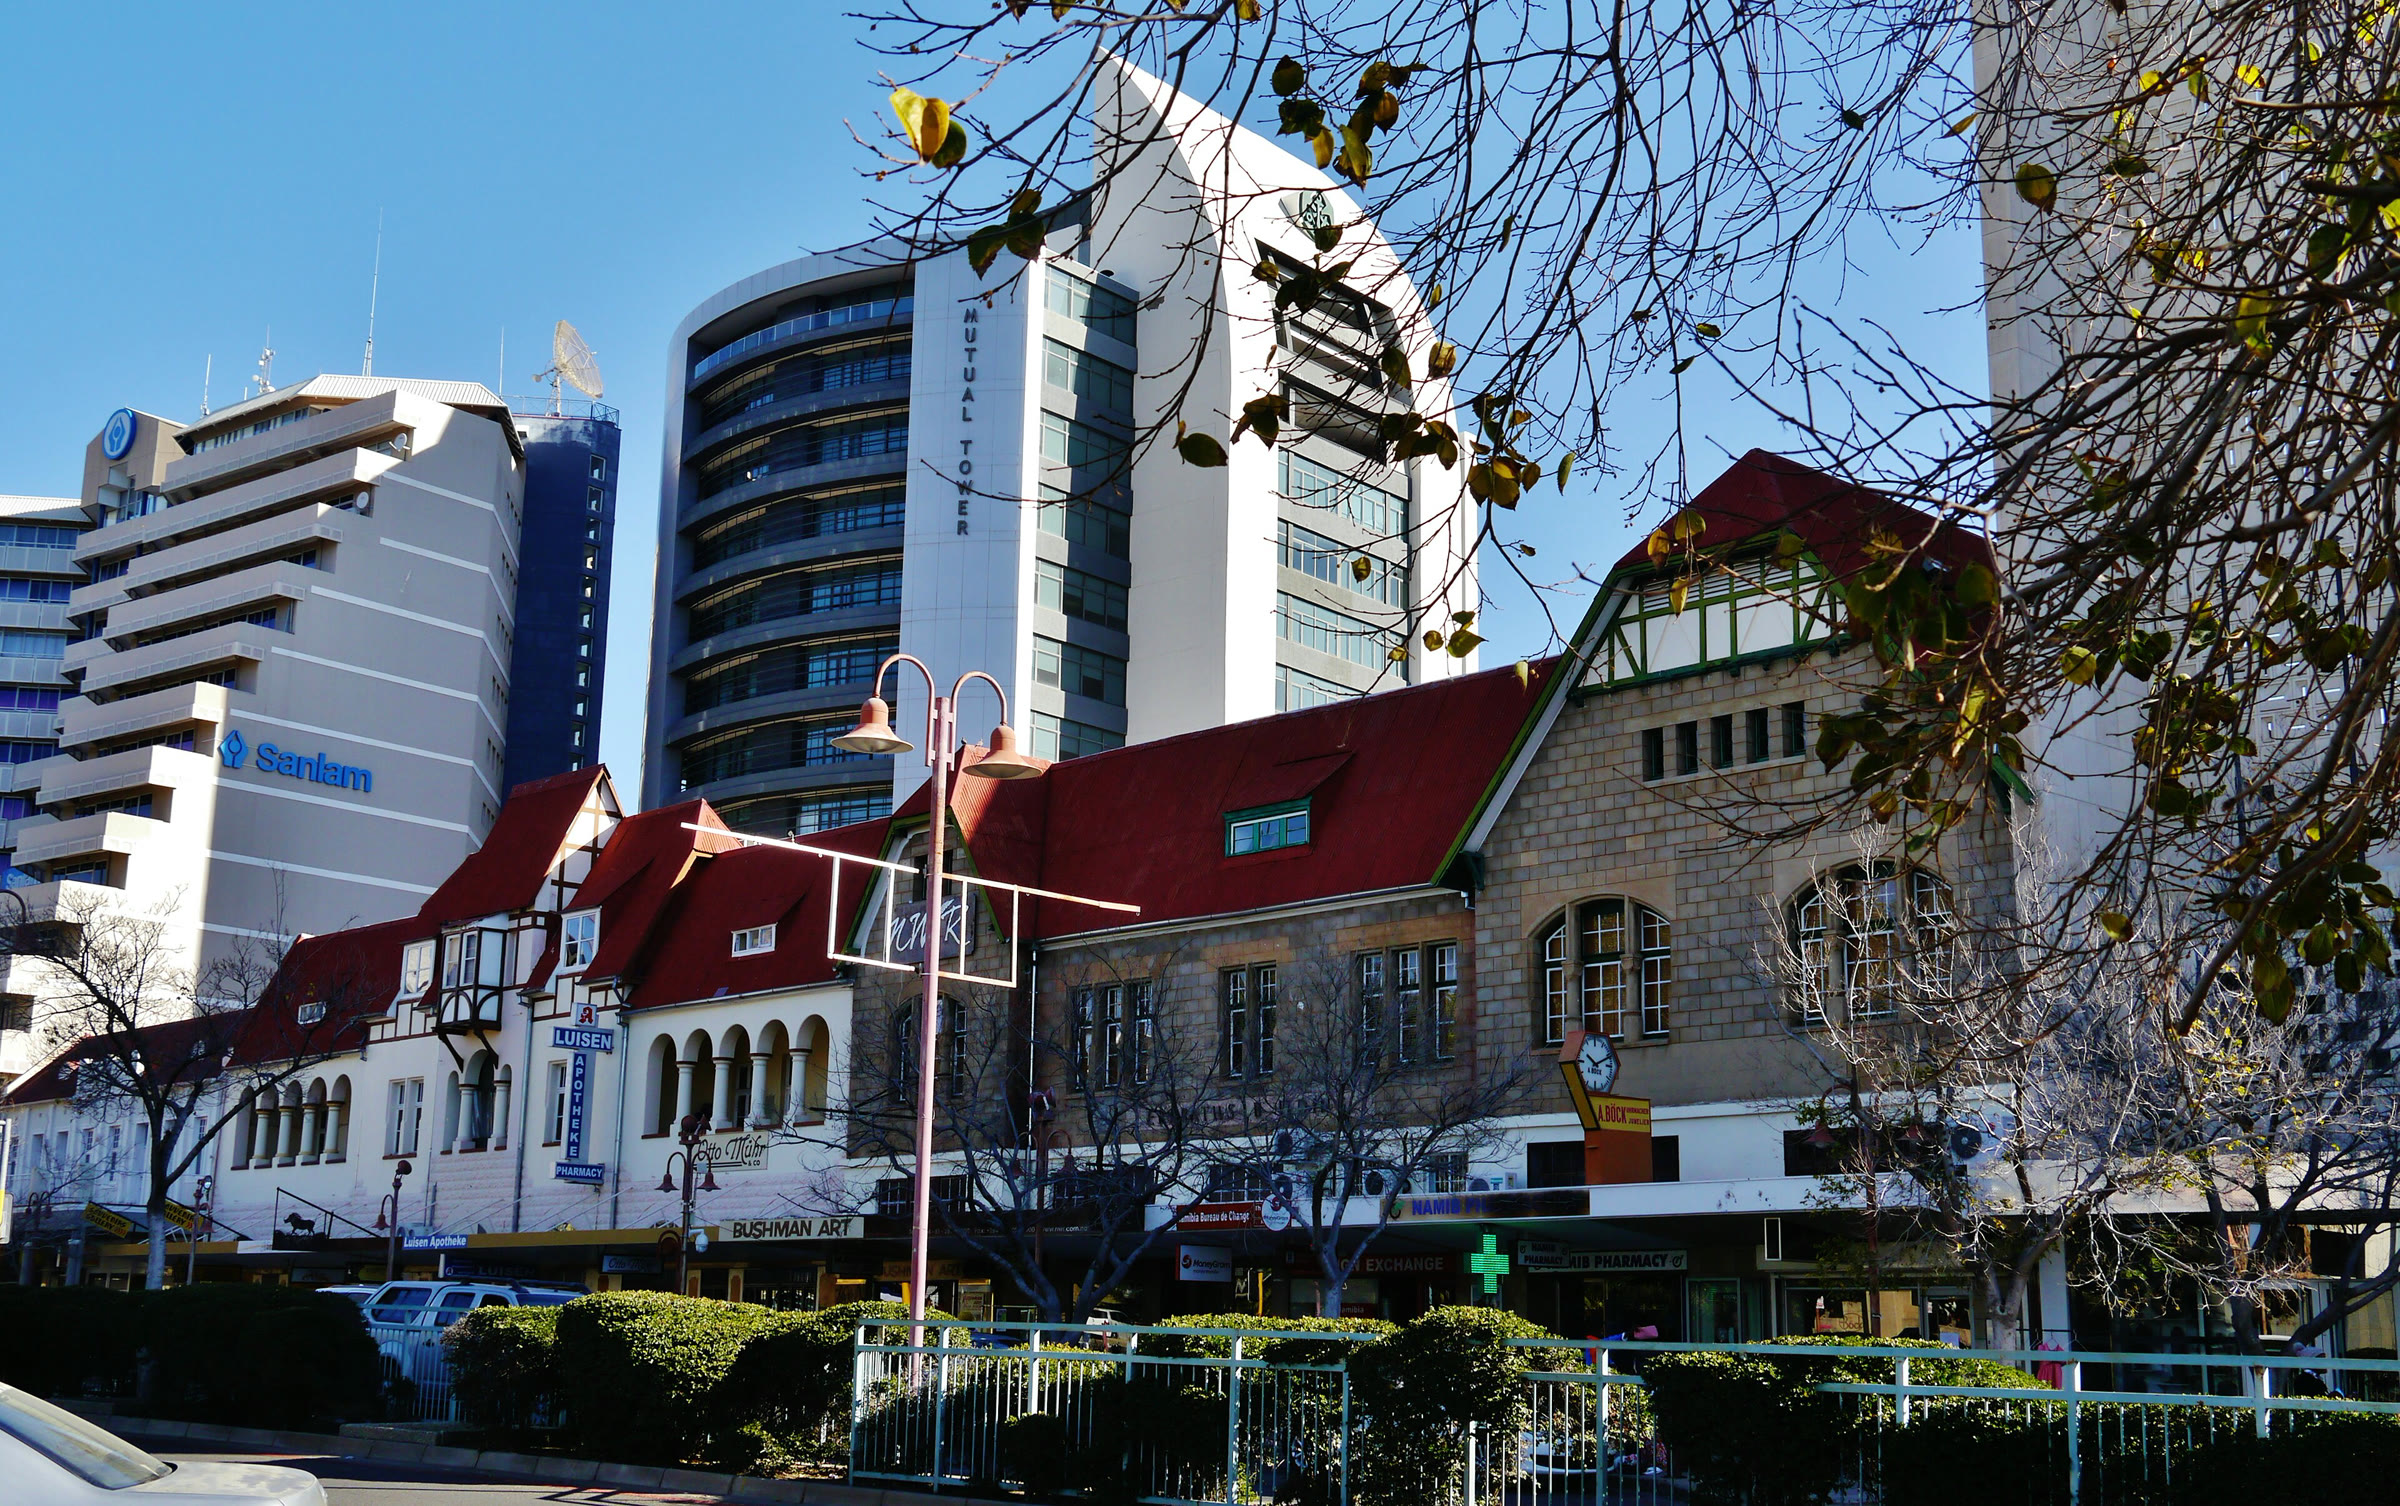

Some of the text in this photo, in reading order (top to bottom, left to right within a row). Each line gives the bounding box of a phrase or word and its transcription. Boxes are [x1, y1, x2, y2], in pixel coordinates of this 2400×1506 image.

[956, 308, 978, 535] MUTUAL TOWER
[256, 742, 372, 792] Sanlam
[555, 1029, 613, 1050] LUISEN
[569, 1055, 585, 1156] APOTHEKE
[698, 1138, 722, 1161] Otto
[556, 1165, 603, 1178] PHARMACY
[1411, 1197, 1461, 1215] NAMIB
[1200, 1211, 1219, 1222] Bureau
[1221, 1211, 1228, 1221] de
[1229, 1210, 1250, 1223] Change
[733, 1218, 852, 1239] BUSHMAN ART
[403, 1236, 467, 1249] Luisen Apotheke
[1193, 1259, 1231, 1269] MoneyGram
[1366, 1256, 1444, 1272] EXCHANGE
[1524, 1254, 1563, 1265] PHARMACY
[1595, 1253, 1668, 1269] PHARMACY
